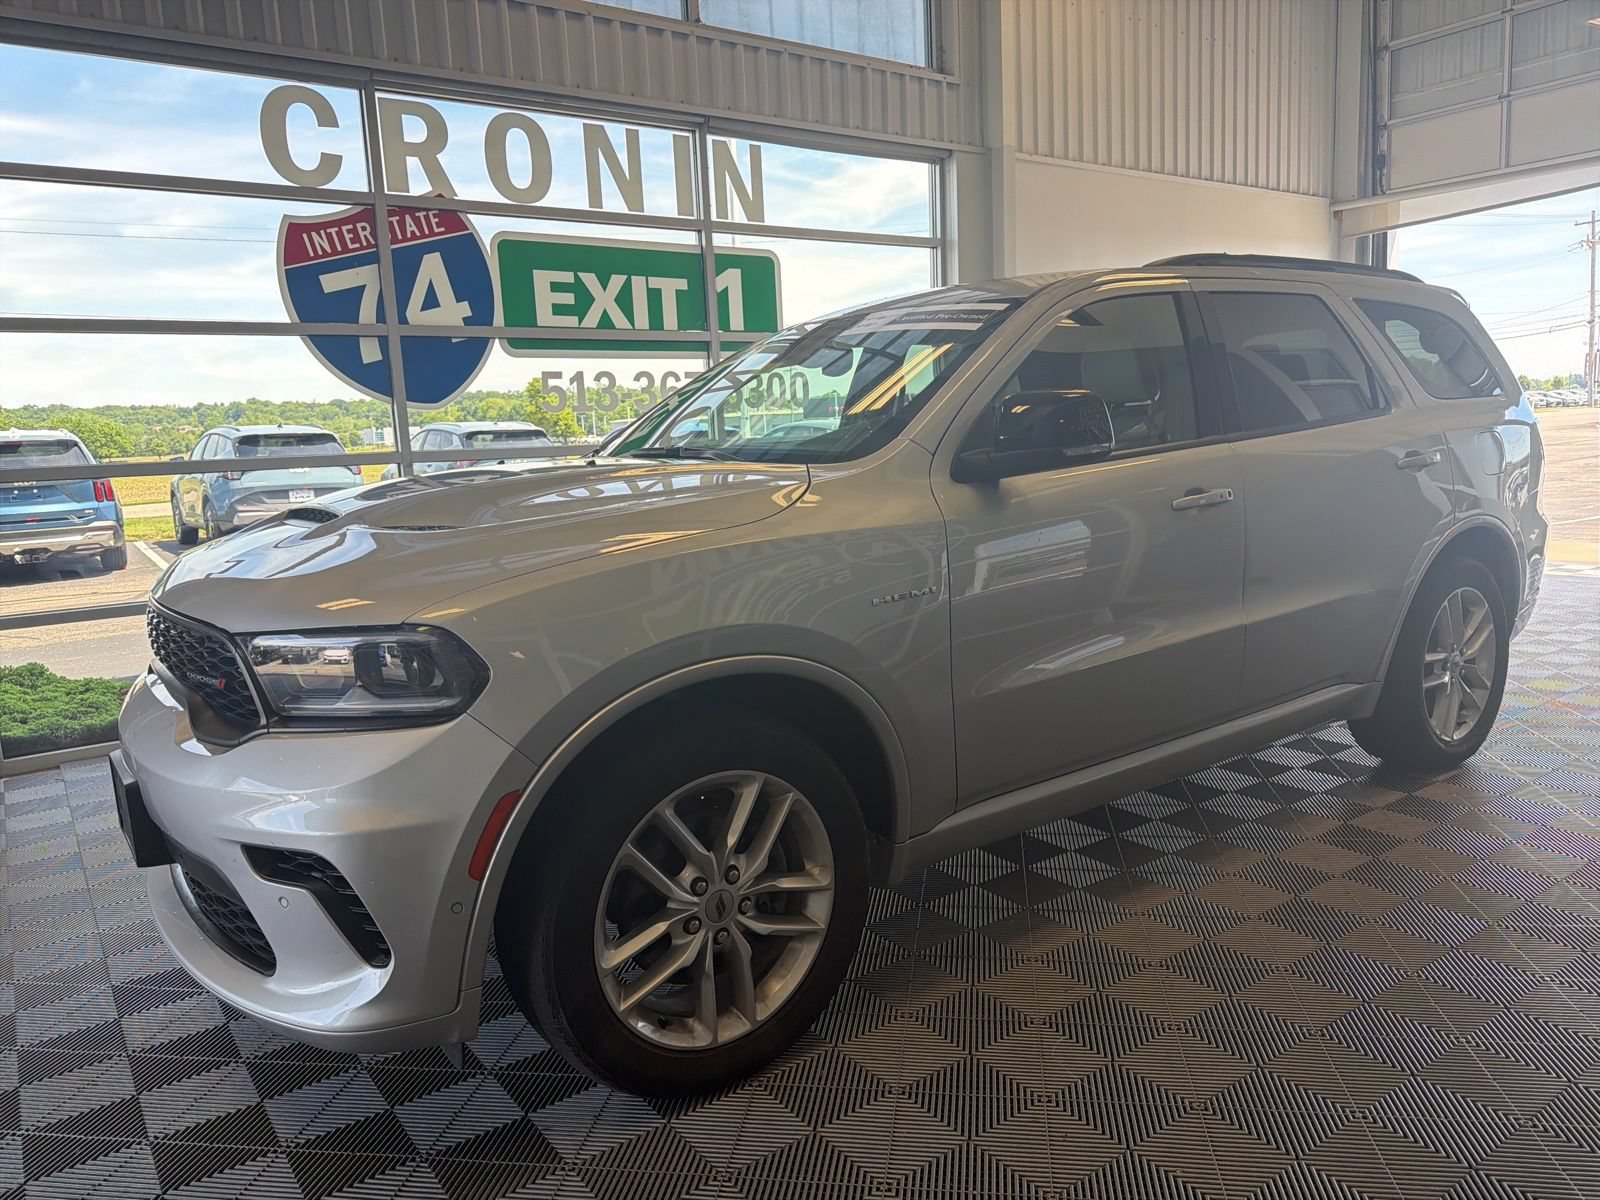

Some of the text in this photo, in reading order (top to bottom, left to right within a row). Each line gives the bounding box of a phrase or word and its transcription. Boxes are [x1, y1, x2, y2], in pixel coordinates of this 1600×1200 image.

[260, 85, 765, 223] CRONIN
[302, 210, 446, 257] INTERTATE
[318, 252, 473, 365] 74
[532, 267, 745, 332] EXIT 1
[935, 310, 989, 321] Pre-Owned
[872, 585, 937, 606] HEMI
